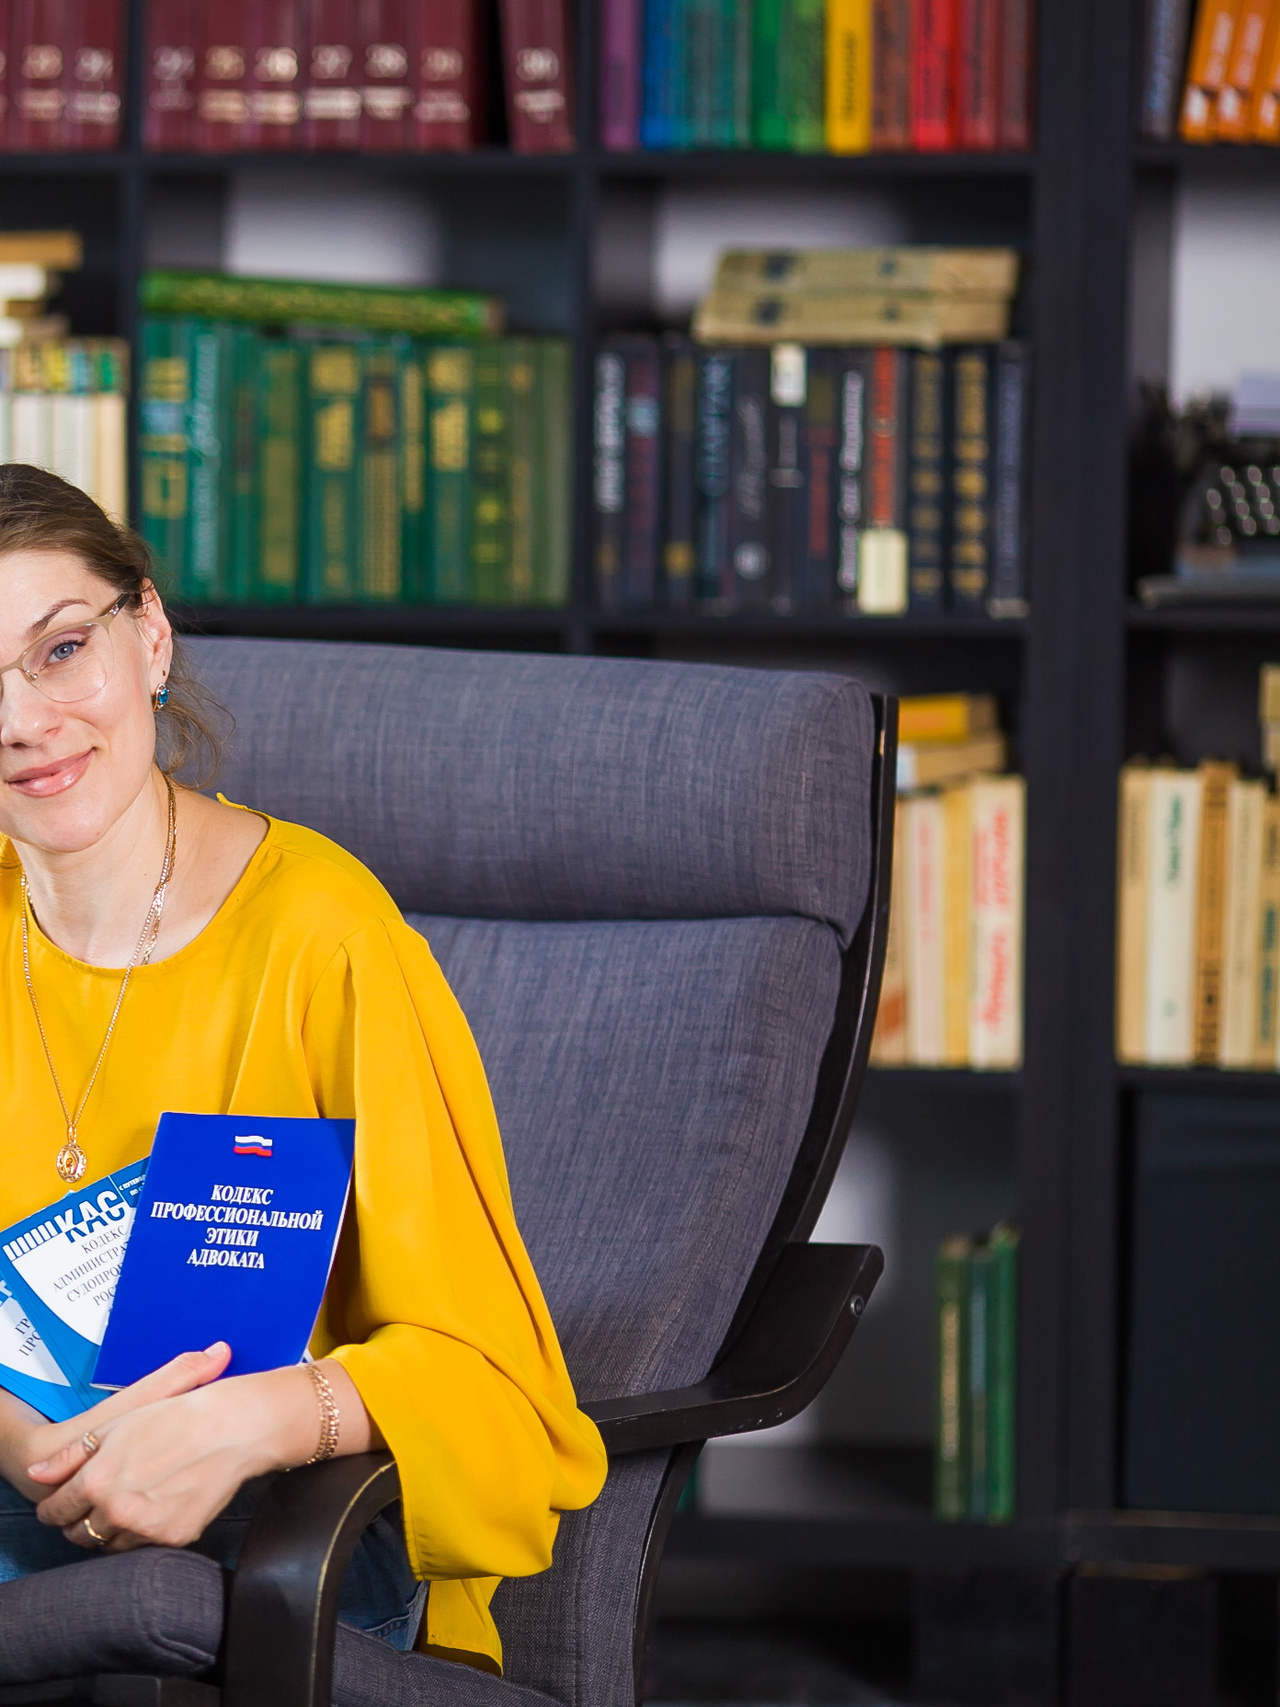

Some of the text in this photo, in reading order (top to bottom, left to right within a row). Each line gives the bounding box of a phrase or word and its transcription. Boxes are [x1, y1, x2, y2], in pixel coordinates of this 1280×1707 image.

[211, 1184, 274, 1205] КОДЕКС
[53, 1190, 125, 1243] КАС
[150, 1201, 324, 1230] ПРОФЕССИОНАЛЬНОЙ
[81, 1225, 128, 1254] КОДЕКС
[205, 1227, 259, 1247] ЭТИКИ
[187, 1249, 265, 1269] АДВОКАТА
